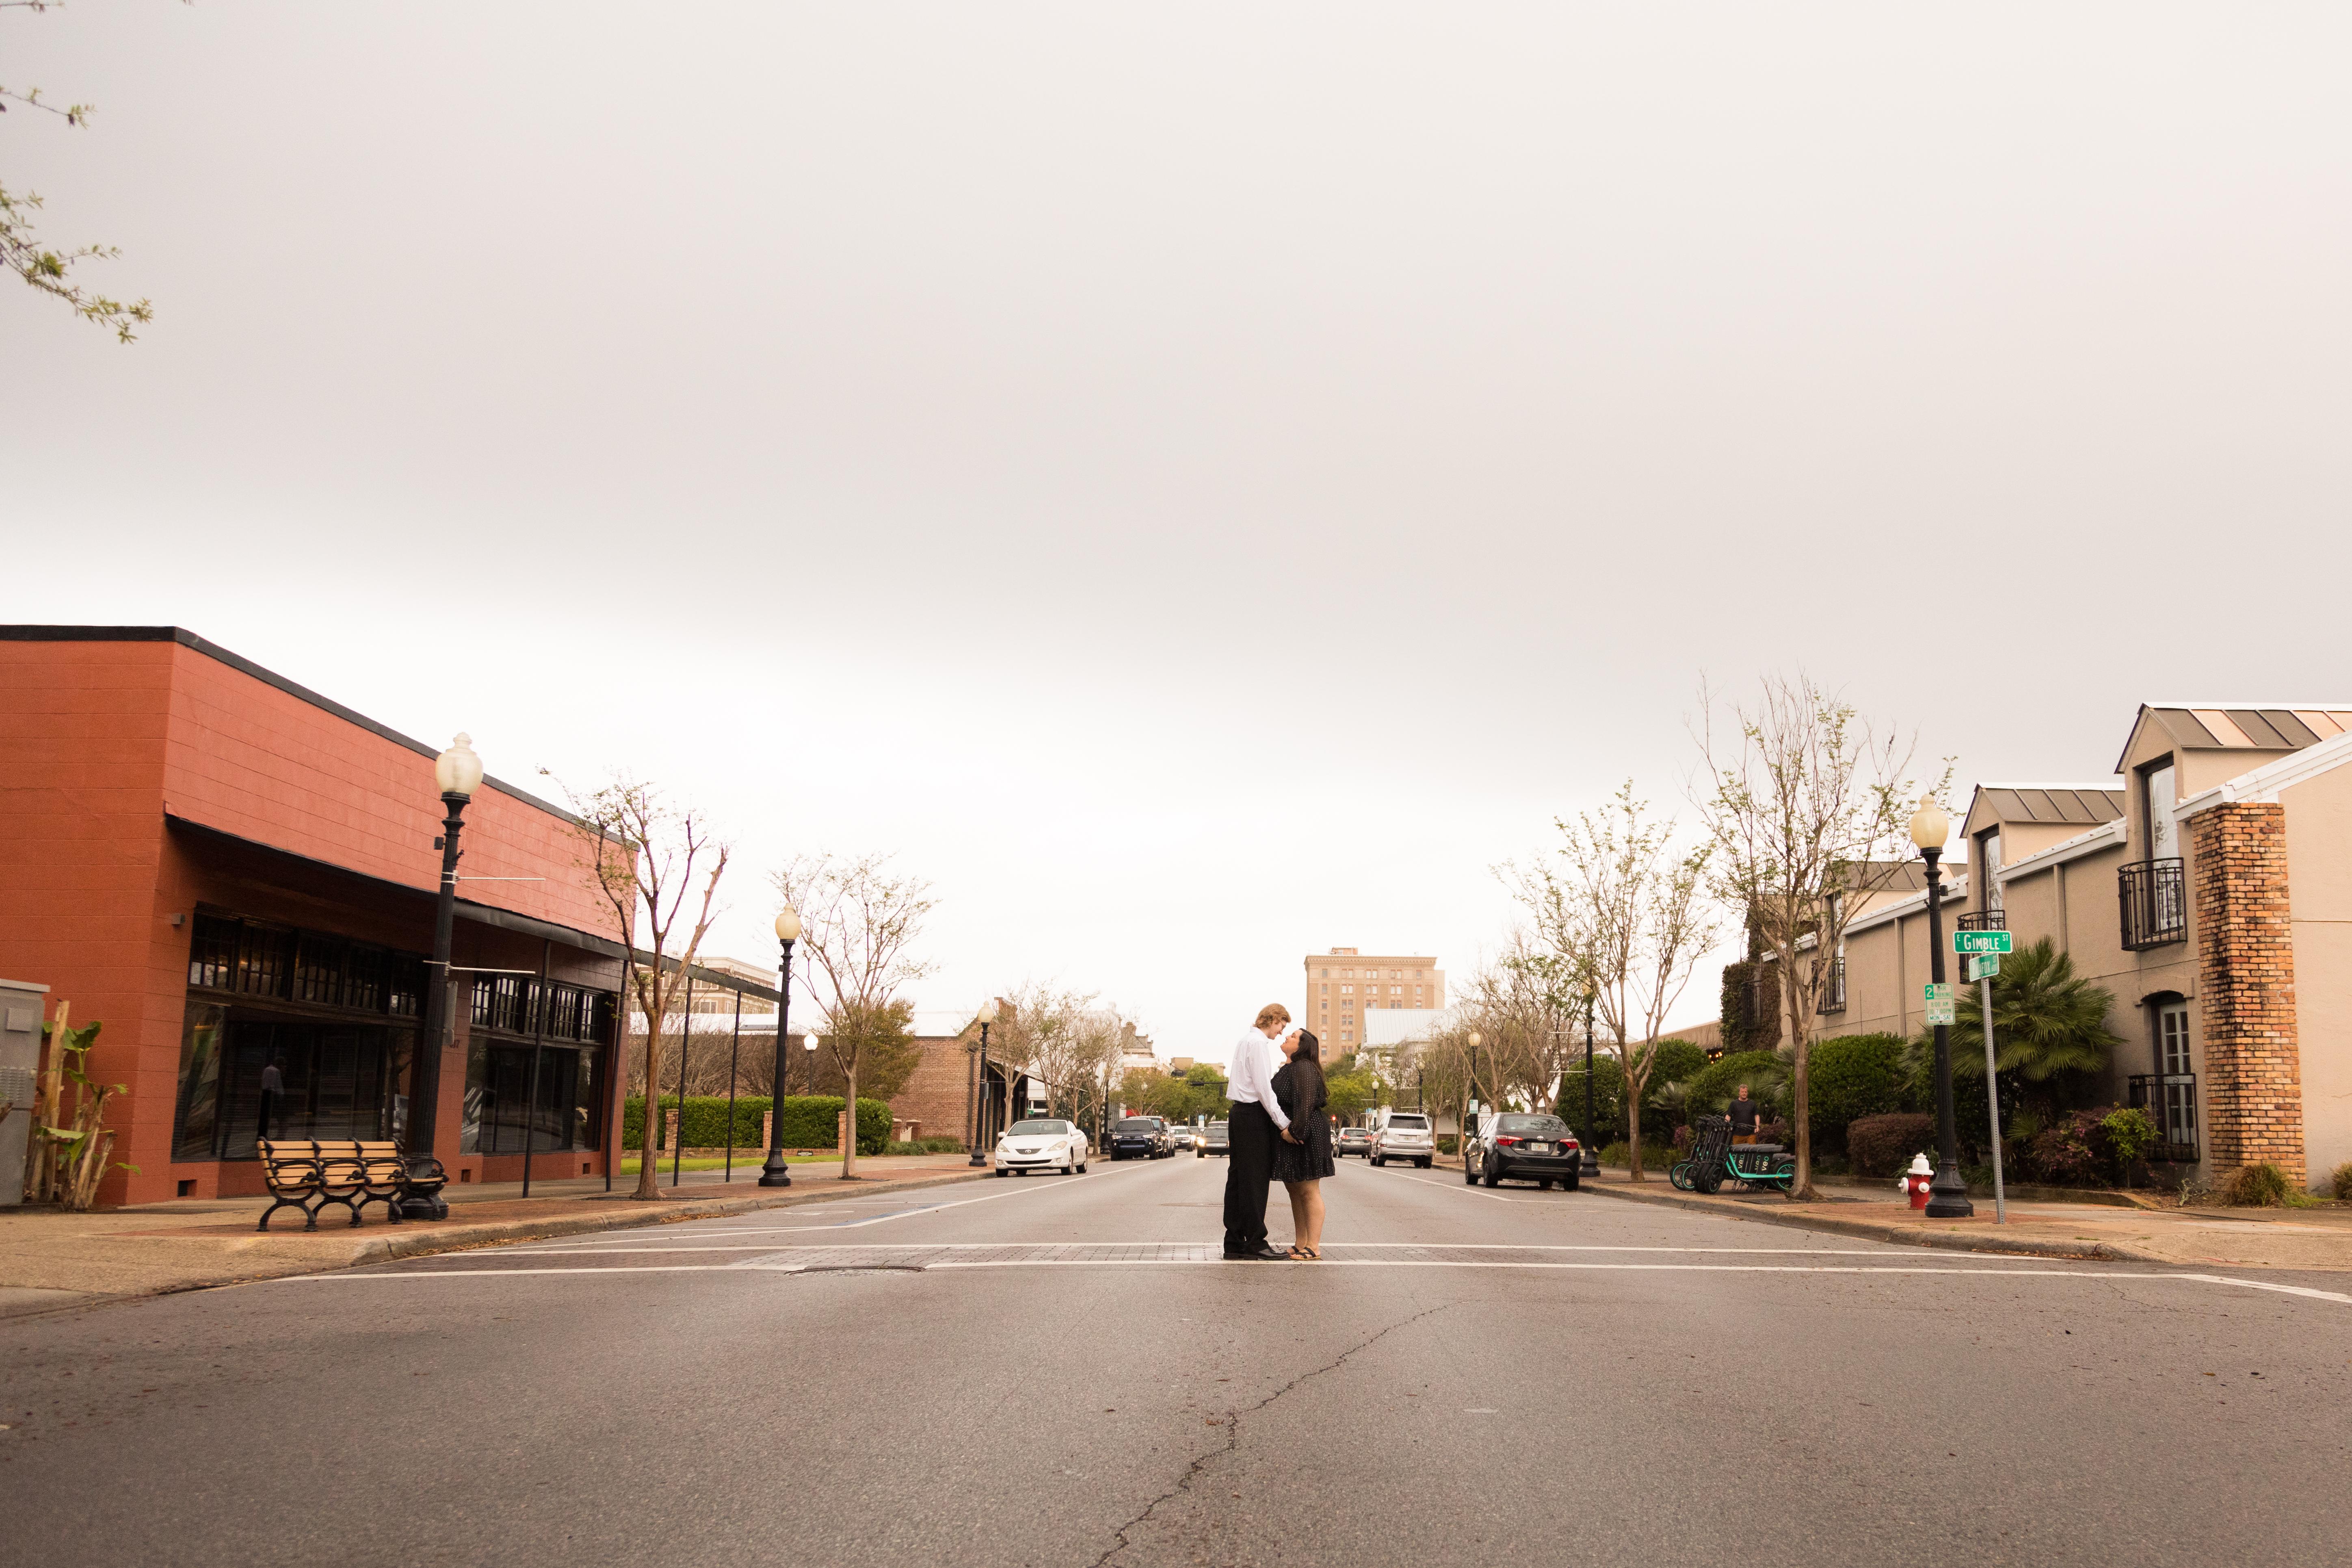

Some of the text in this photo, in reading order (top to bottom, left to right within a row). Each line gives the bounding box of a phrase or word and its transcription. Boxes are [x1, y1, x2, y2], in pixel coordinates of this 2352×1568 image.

[1964, 934, 2000, 950] GIMBLE
[1926, 987, 1932, 997] 2
[1761, 1156, 1769, 1171] veo
